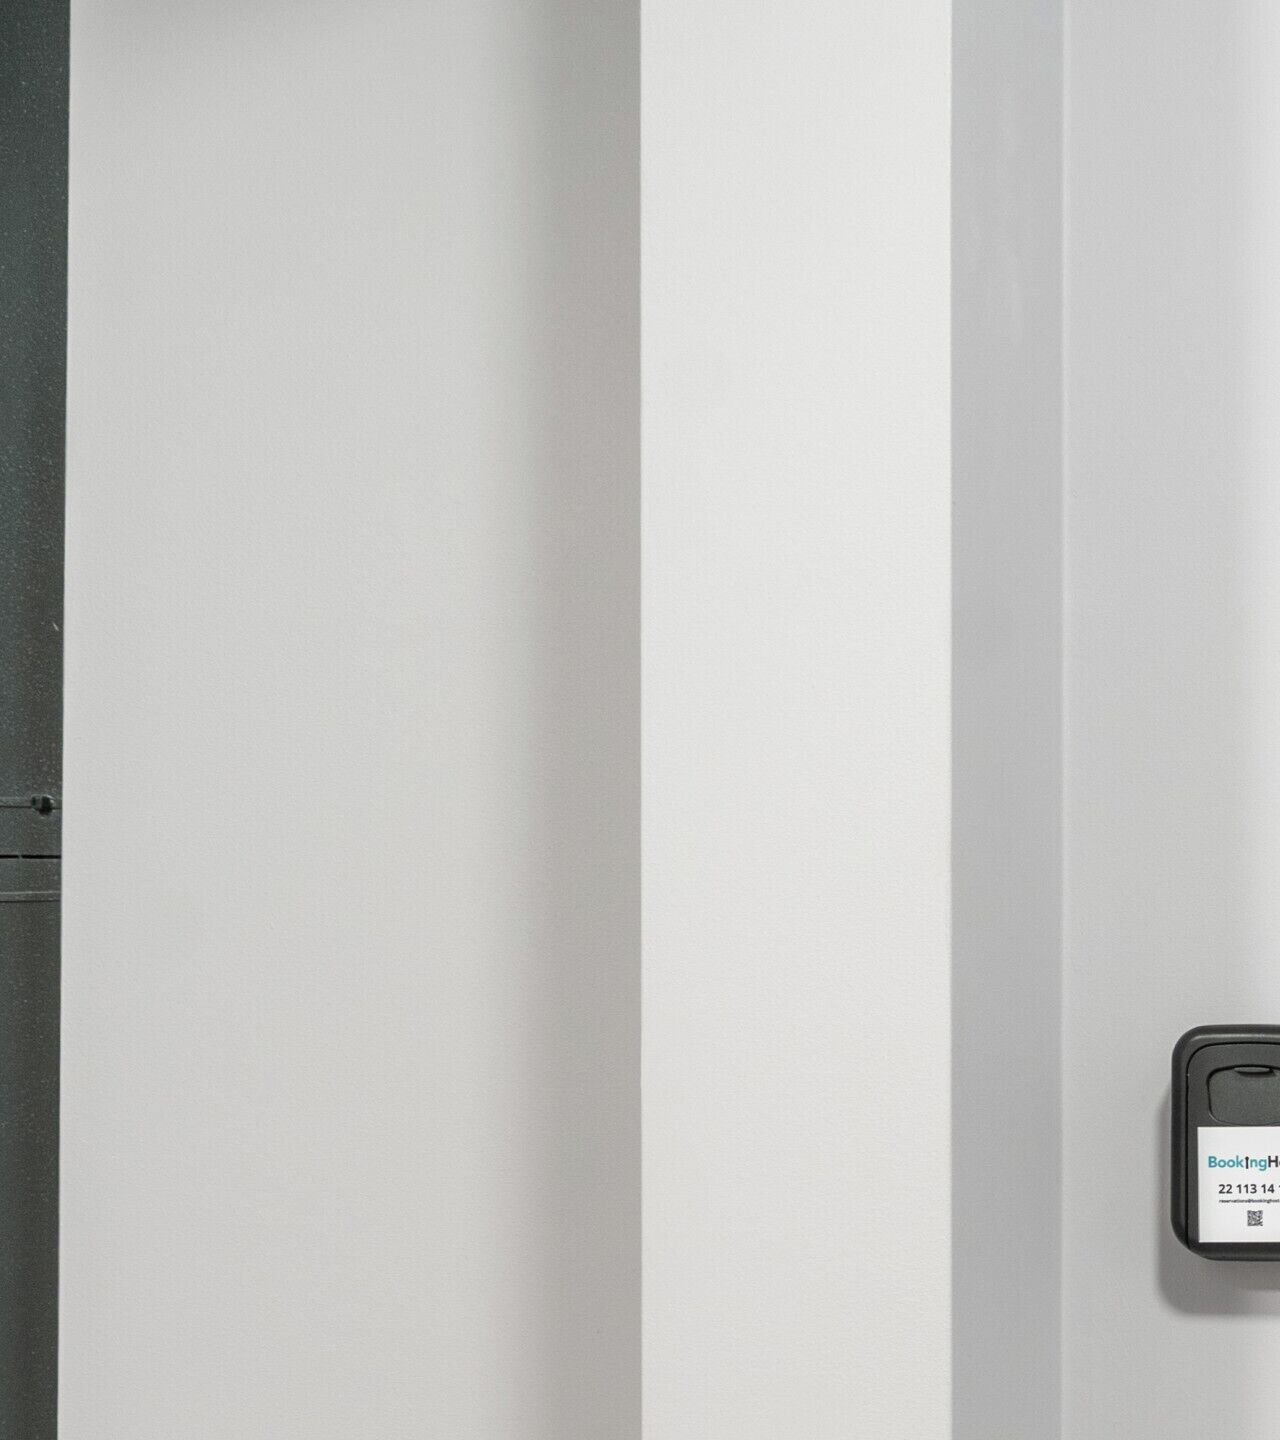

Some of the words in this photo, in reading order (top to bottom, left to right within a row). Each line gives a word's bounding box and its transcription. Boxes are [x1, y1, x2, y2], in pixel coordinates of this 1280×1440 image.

[1218, 1184, 1233, 1194] 22
[1236, 1184, 1257, 1194] 113
[1261, 1184, 1275, 1194] 14
